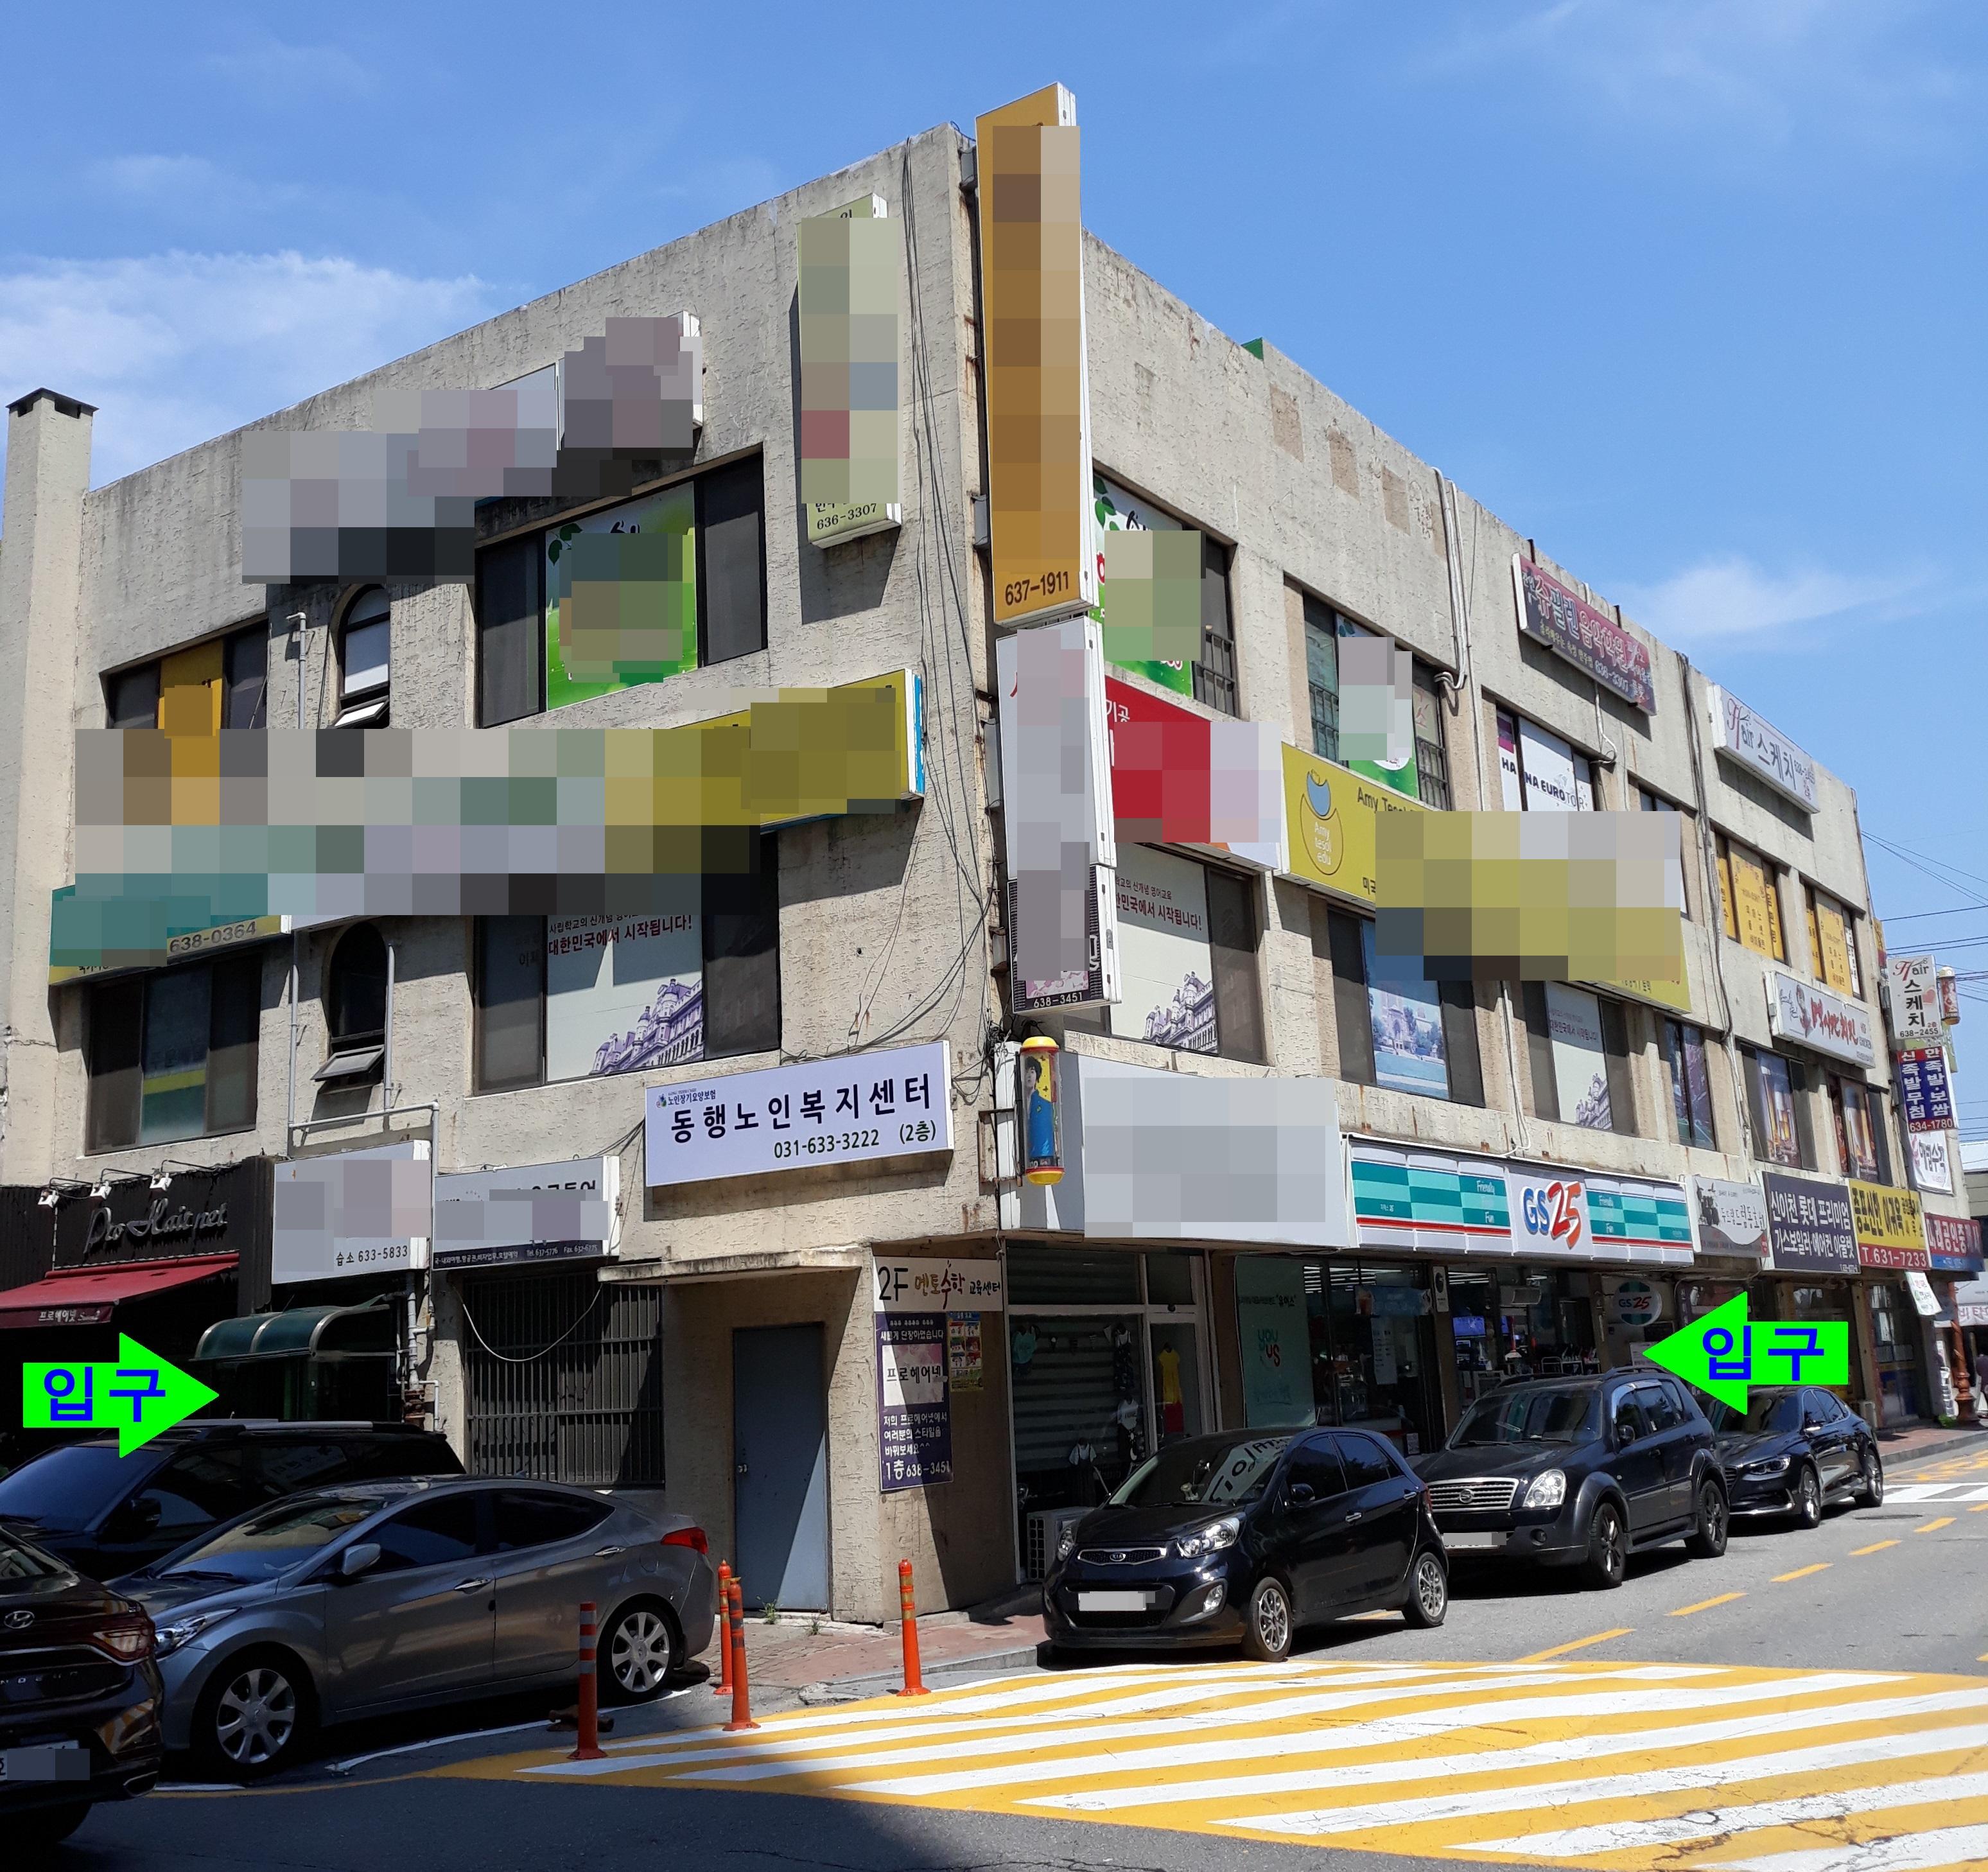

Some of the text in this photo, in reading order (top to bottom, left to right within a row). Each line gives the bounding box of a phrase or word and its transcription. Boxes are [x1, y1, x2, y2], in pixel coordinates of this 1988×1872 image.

[817, 503, 876, 529] 636-3307
[1005, 572, 1068, 606] 637-1911
[1758, 733, 1797, 791] 스케치
[1158, 905, 1202, 931] 시작됩니다!
[169, 920, 256, 953] 638-0364
[548, 914, 692, 956] 대한민국에서 시작됩니다!
[1033, 992, 1083, 1008] 638-3451
[1904, 979, 1925, 1027] 스케치
[1899, 1028, 1939, 1038] 638-2455
[668, 1089, 716, 1105] 노인장기요양보험
[671, 1073, 930, 1144] 동행노인복지센터
[774, 1119, 936, 1158] 031-633-3222 (2층)
[1910, 1119, 1953, 1133] 634-1780
[1521, 1180, 1582, 1250] GS25
[1799, 1195, 1818, 1227] 롯데
[1818, 1200, 1851, 1230] 프리미엄
[358, 1245, 408, 1263] 633-5833
[1862, 1247, 1926, 1267] T.631-7233
[878, 1259, 1000, 1309] 2F 멘토수학 교육센터
[884, 1414, 898, 1427] 저희
[884, 1426, 941, 1442] 여러분의 스타일을
[885, 1459, 950, 1482] 1층 638-3451
